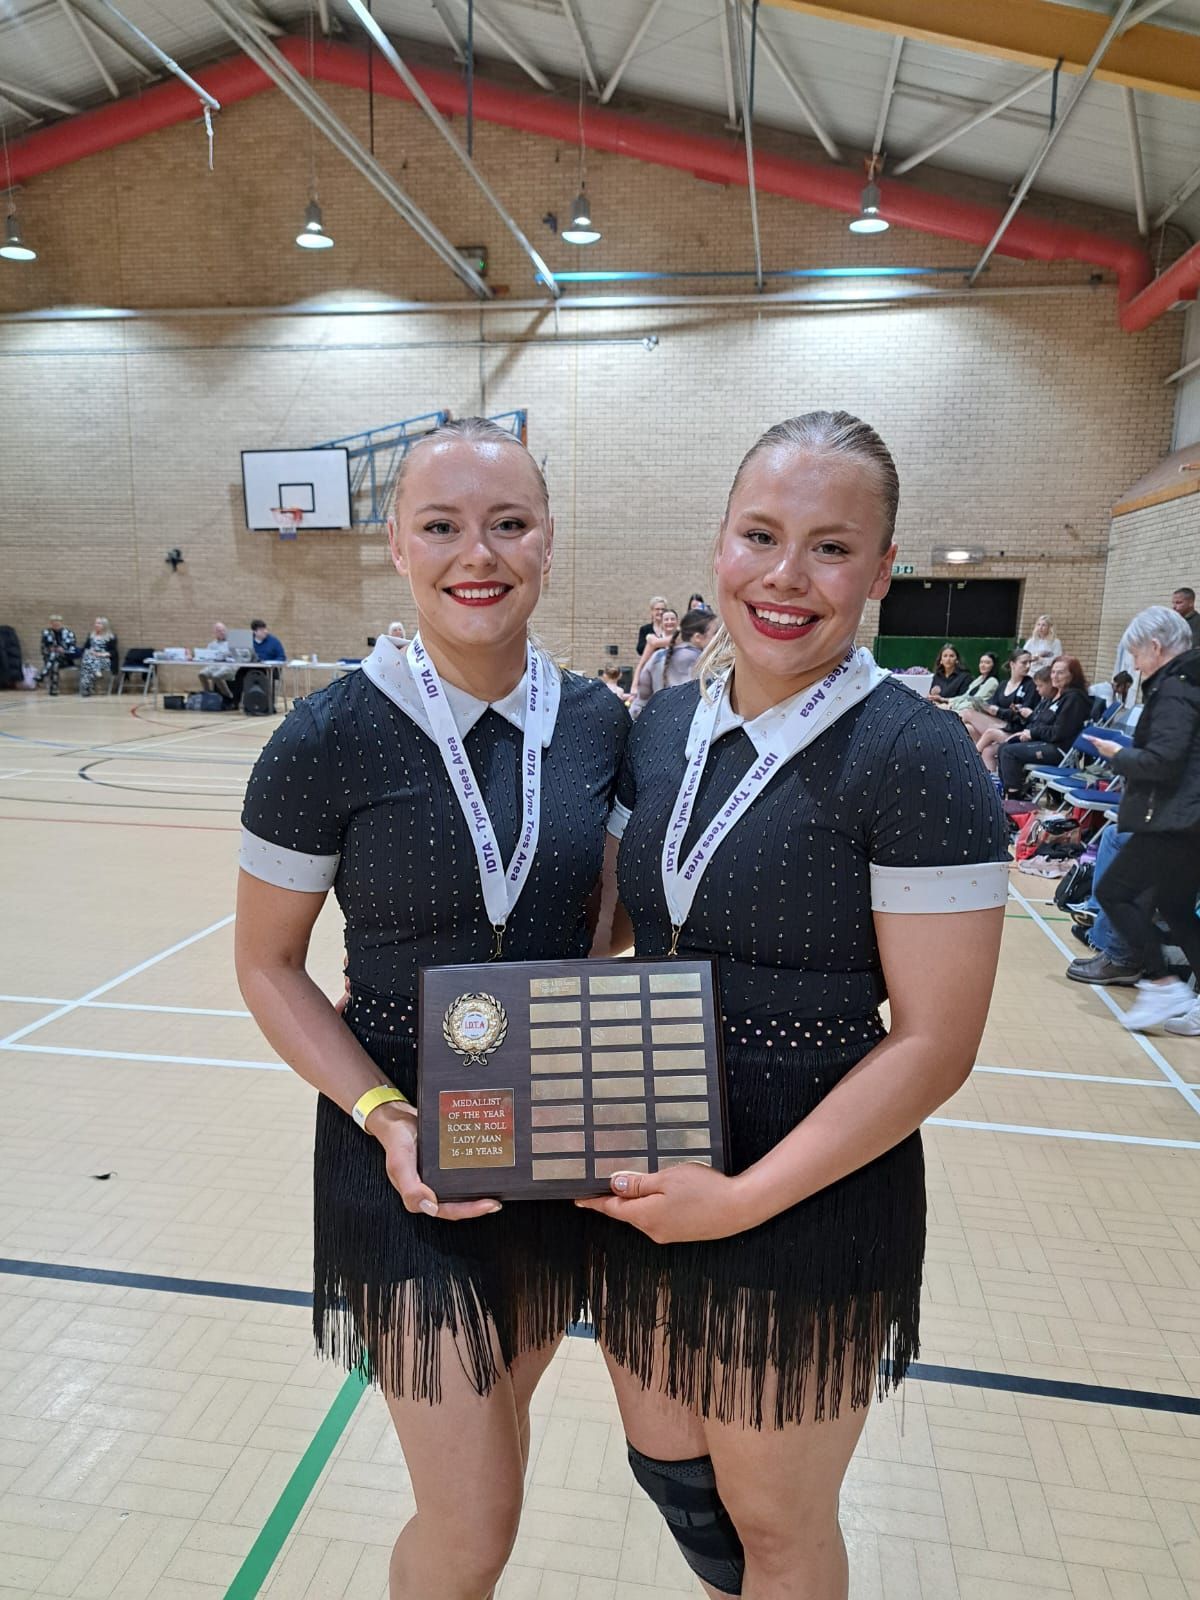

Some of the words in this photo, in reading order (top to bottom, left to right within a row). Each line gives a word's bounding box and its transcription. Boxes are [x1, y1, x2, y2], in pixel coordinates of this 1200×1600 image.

[421, 669, 439, 698] IDTA
[823, 665, 848, 688] Tees
[530, 684, 538, 712] Area
[800, 689, 825, 717] Area
[448, 737, 464, 764] Area
[527, 749, 536, 776] IDTA
[752, 752, 778, 780] IDTA
[459, 769, 474, 799] Tees
[525, 788, 534, 815] Tyne
[667, 840, 677, 872] IDTA
[673, 802, 688, 830] Tyne
[683, 770, 698, 798] Tees
[694, 740, 707, 766] Area
[724, 791, 750, 817] Tyne
[471, 801, 487, 832] Tyne
[522, 820, 534, 848] Tees
[703, 821, 727, 848] Tees
[482, 842, 497, 873] IDTA
[511, 852, 527, 881] Area
[684, 850, 704, 880] Area
[452, 1098, 502, 1107] MEDALLIST
[463, 1111, 480, 1119] THE
[483, 1110, 505, 1118] YEAR
[448, 1124, 472, 1132] ROCK
[484, 1122, 507, 1130] ROLL
[476, 1147, 503, 1155] YEARS
